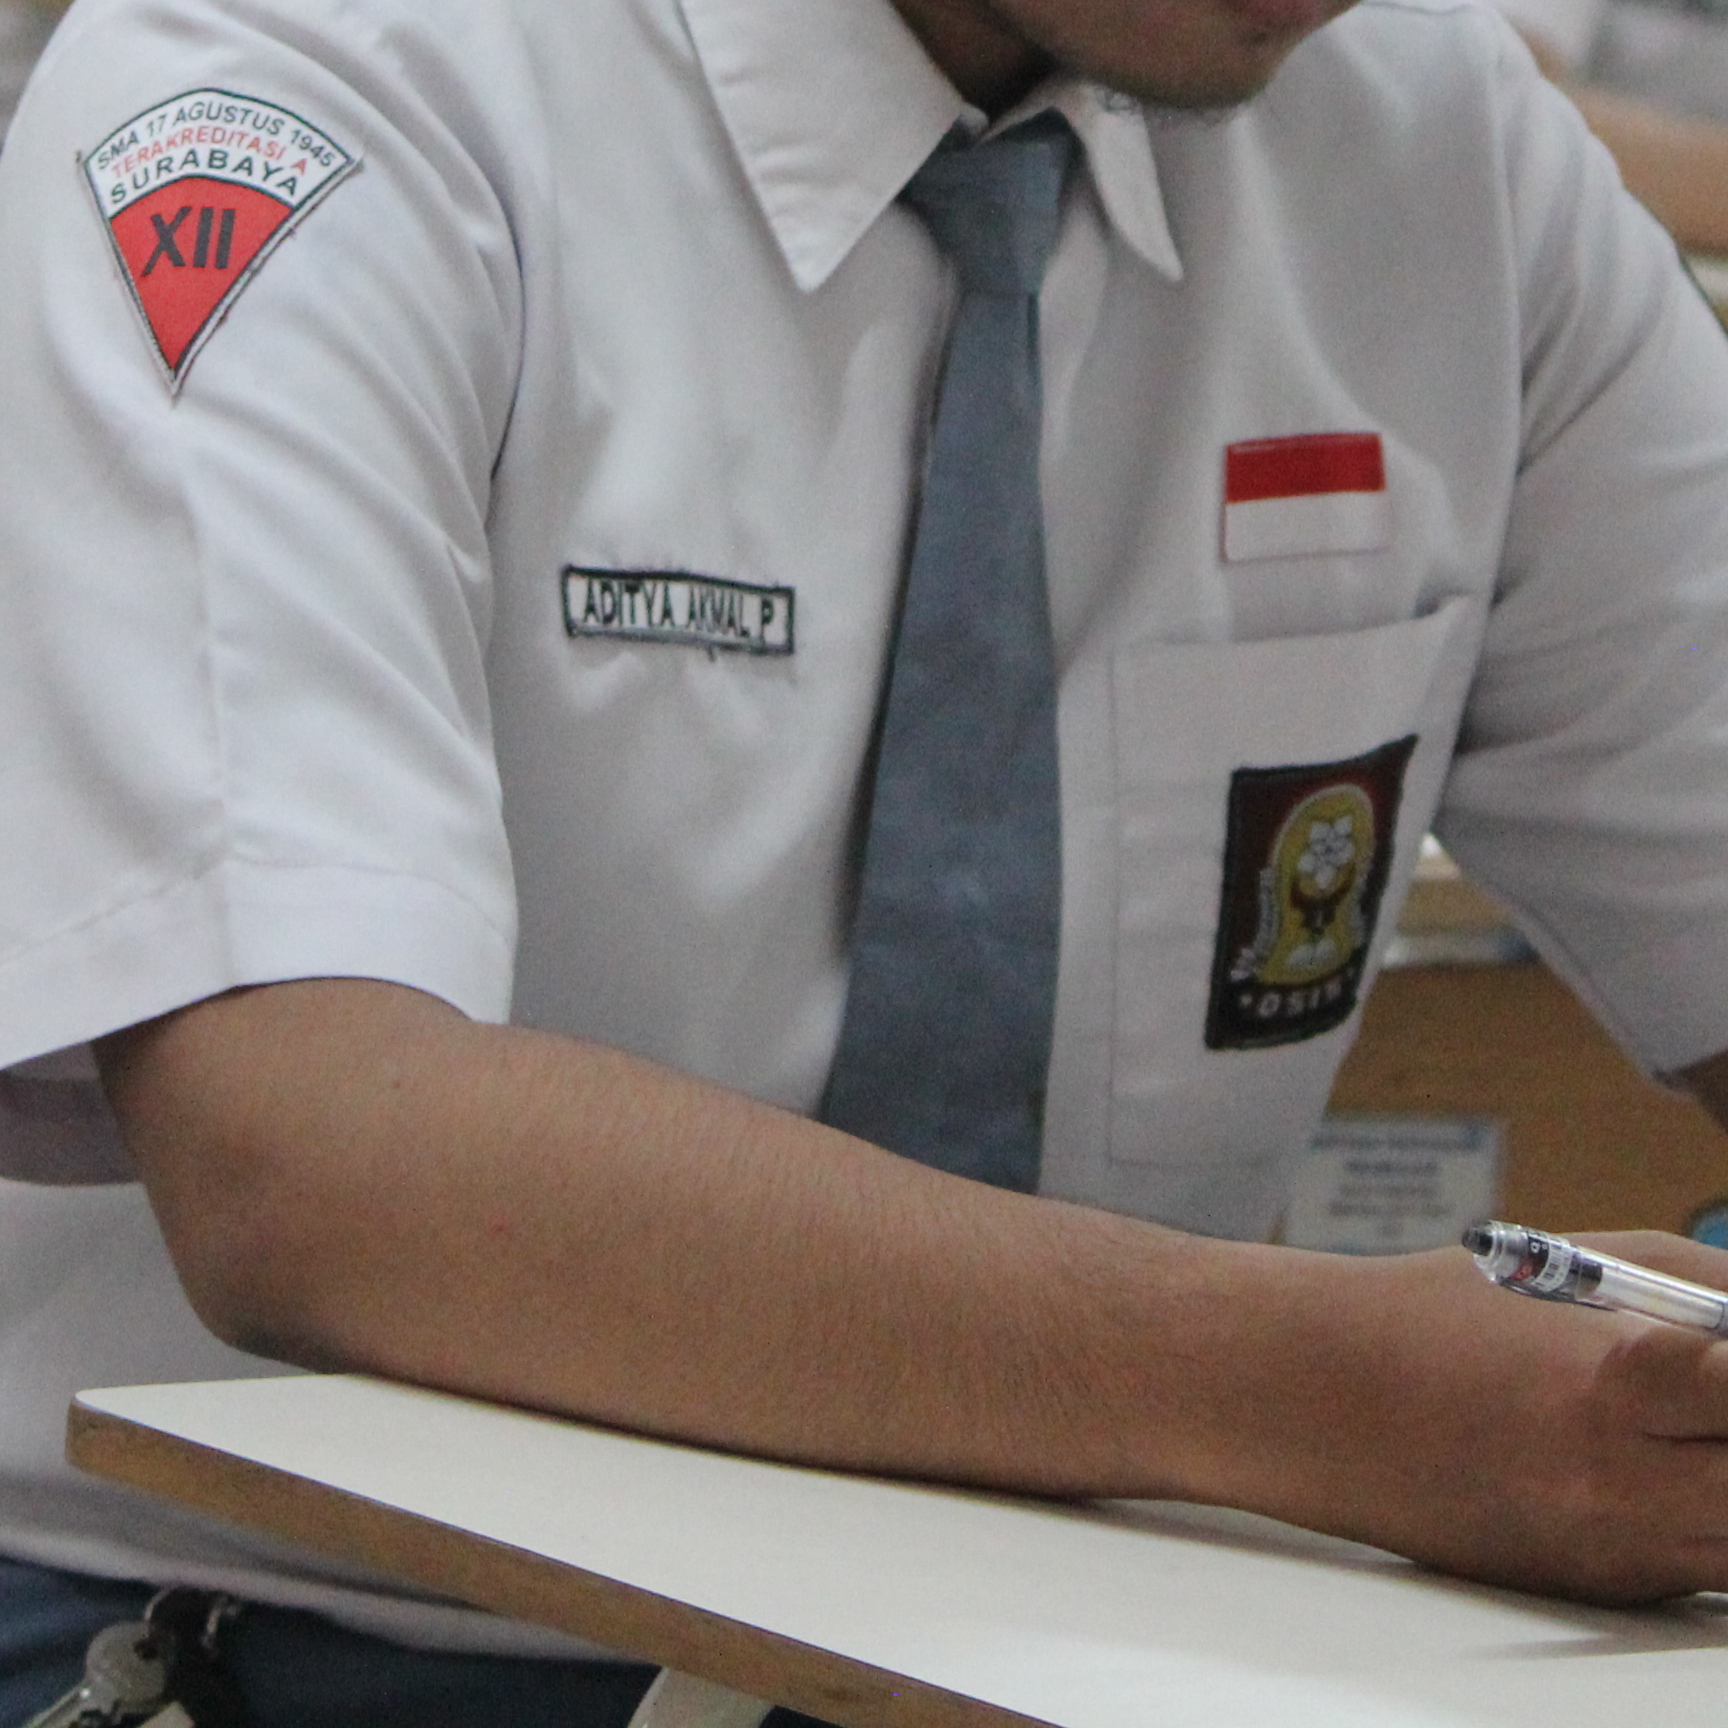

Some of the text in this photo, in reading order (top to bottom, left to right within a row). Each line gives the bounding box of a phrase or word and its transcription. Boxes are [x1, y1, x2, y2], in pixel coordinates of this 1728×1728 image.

[97, 101, 336, 170] SMA 17 AGUSTUS 1945
[111, 125, 308, 179] TERAKREDITASI A
[110, 149, 296, 204] SURABAYA
[141, 205, 236, 278] XII
[584, 577, 675, 628] ADITYA
